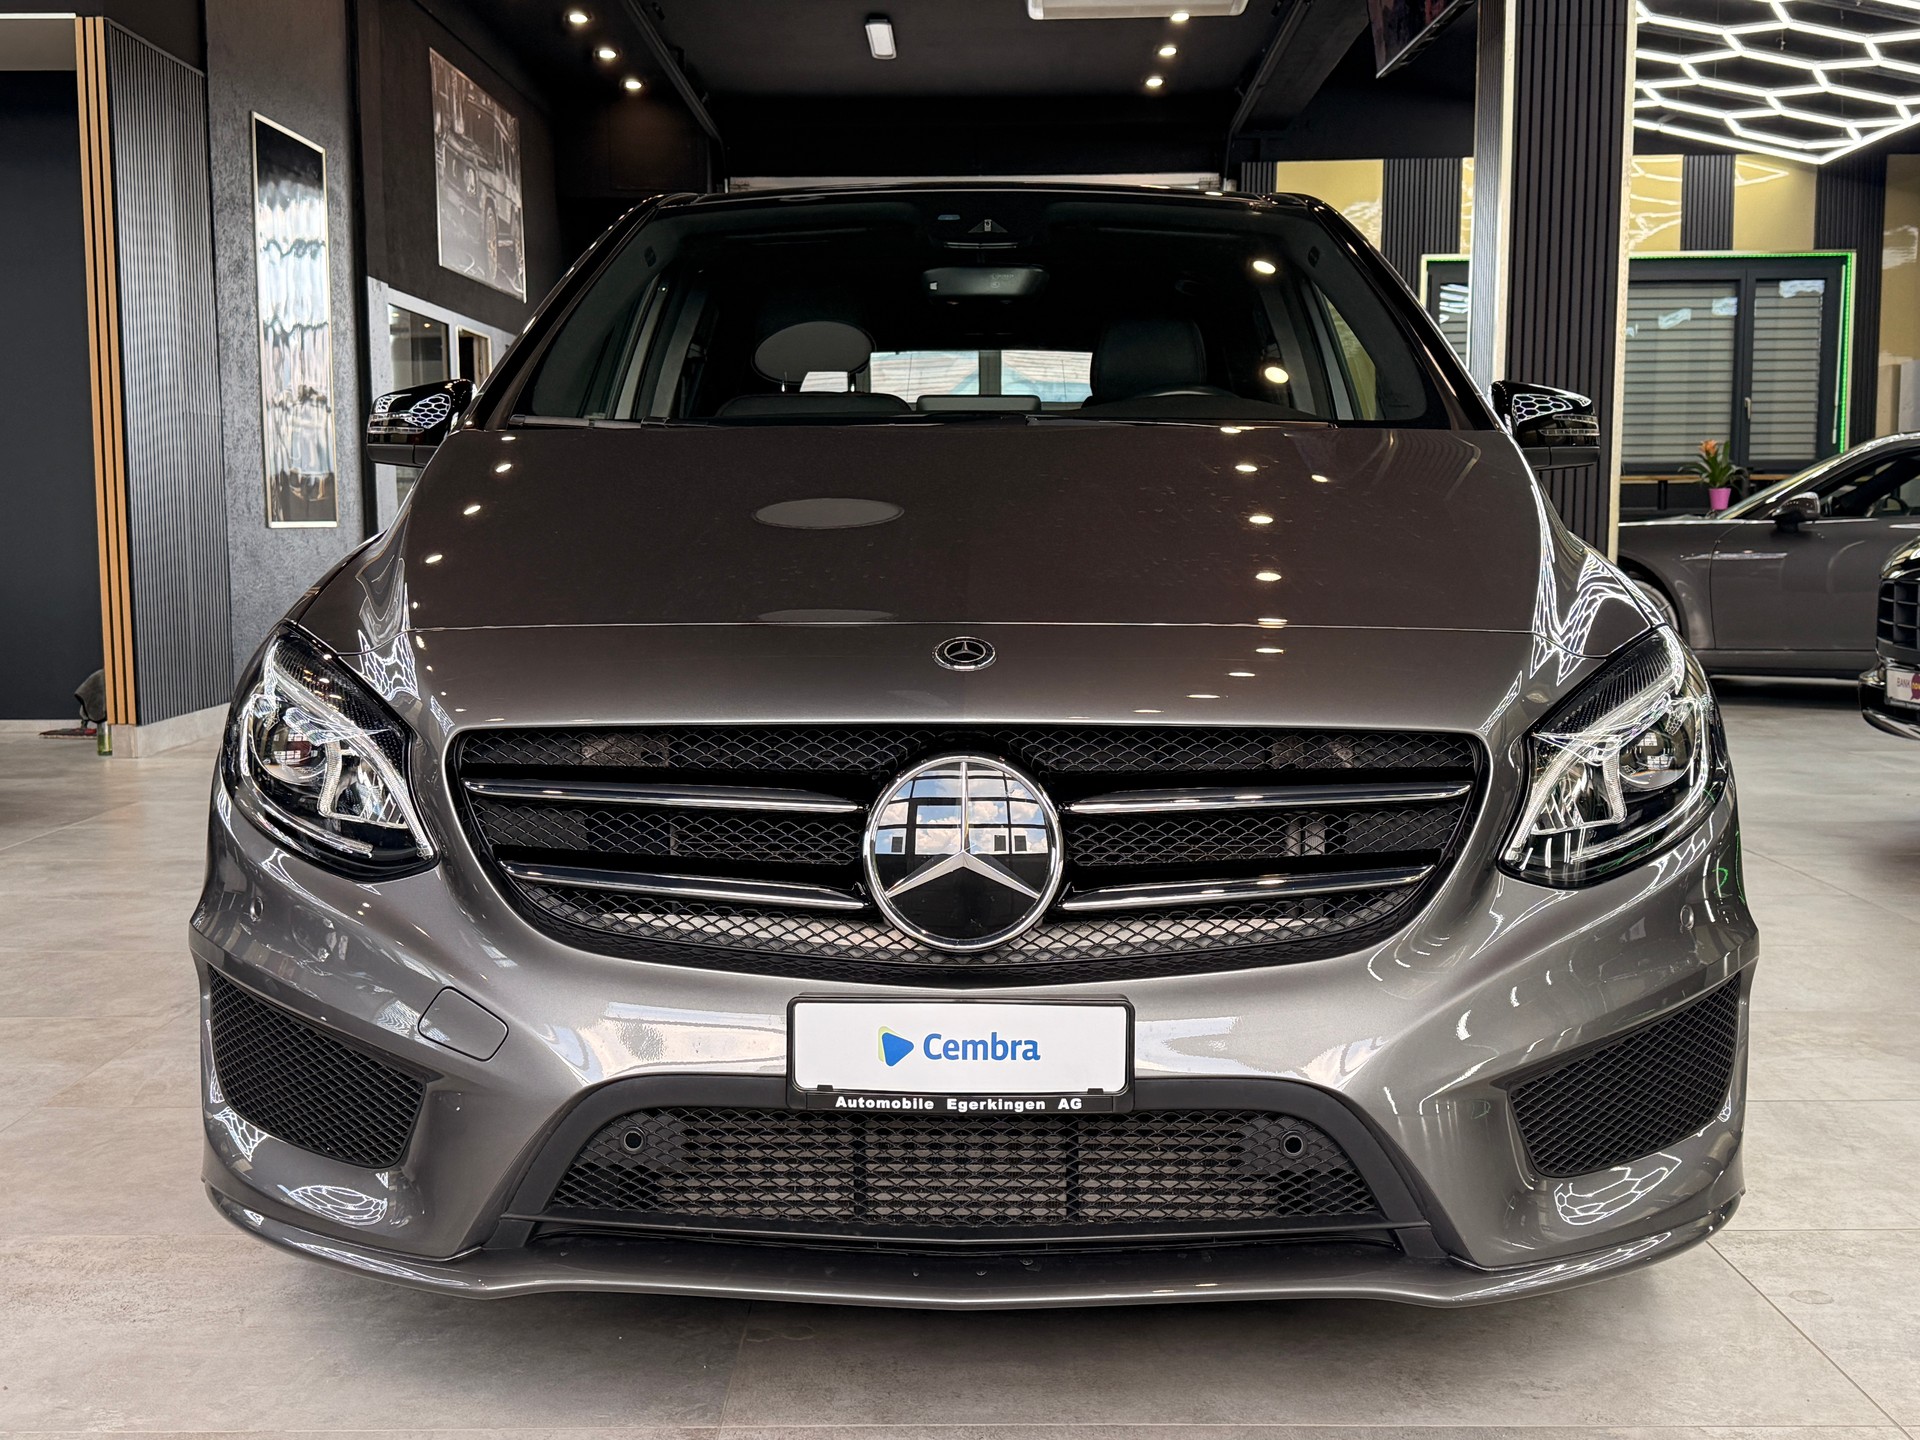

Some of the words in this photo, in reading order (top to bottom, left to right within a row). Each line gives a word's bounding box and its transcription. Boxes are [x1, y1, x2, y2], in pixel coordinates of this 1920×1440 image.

[923, 1032, 1041, 1061] Cembra
[835, 1096, 935, 1110] Automobile
[946, 1097, 1046, 1113] Egerkingen
[1057, 1097, 1083, 1110] AG
